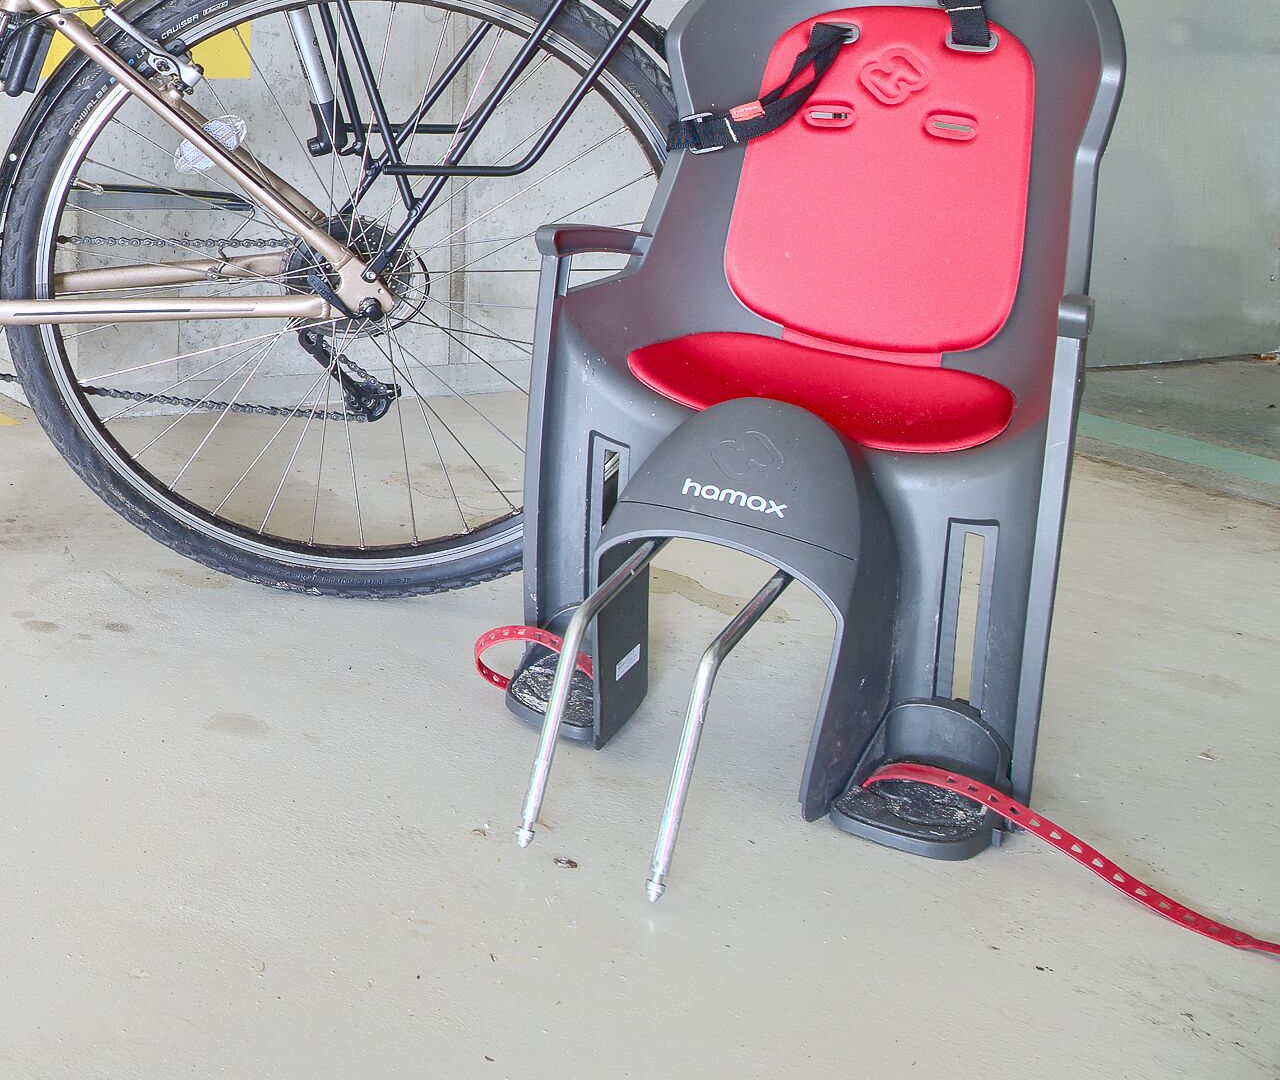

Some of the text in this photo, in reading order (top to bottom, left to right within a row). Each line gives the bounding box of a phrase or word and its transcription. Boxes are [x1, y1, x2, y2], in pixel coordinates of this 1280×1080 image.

[68, 84, 109, 137] SCHWALBE
[160, 14, 200, 40] CRUISER
[681, 477, 788, 519] hamax
